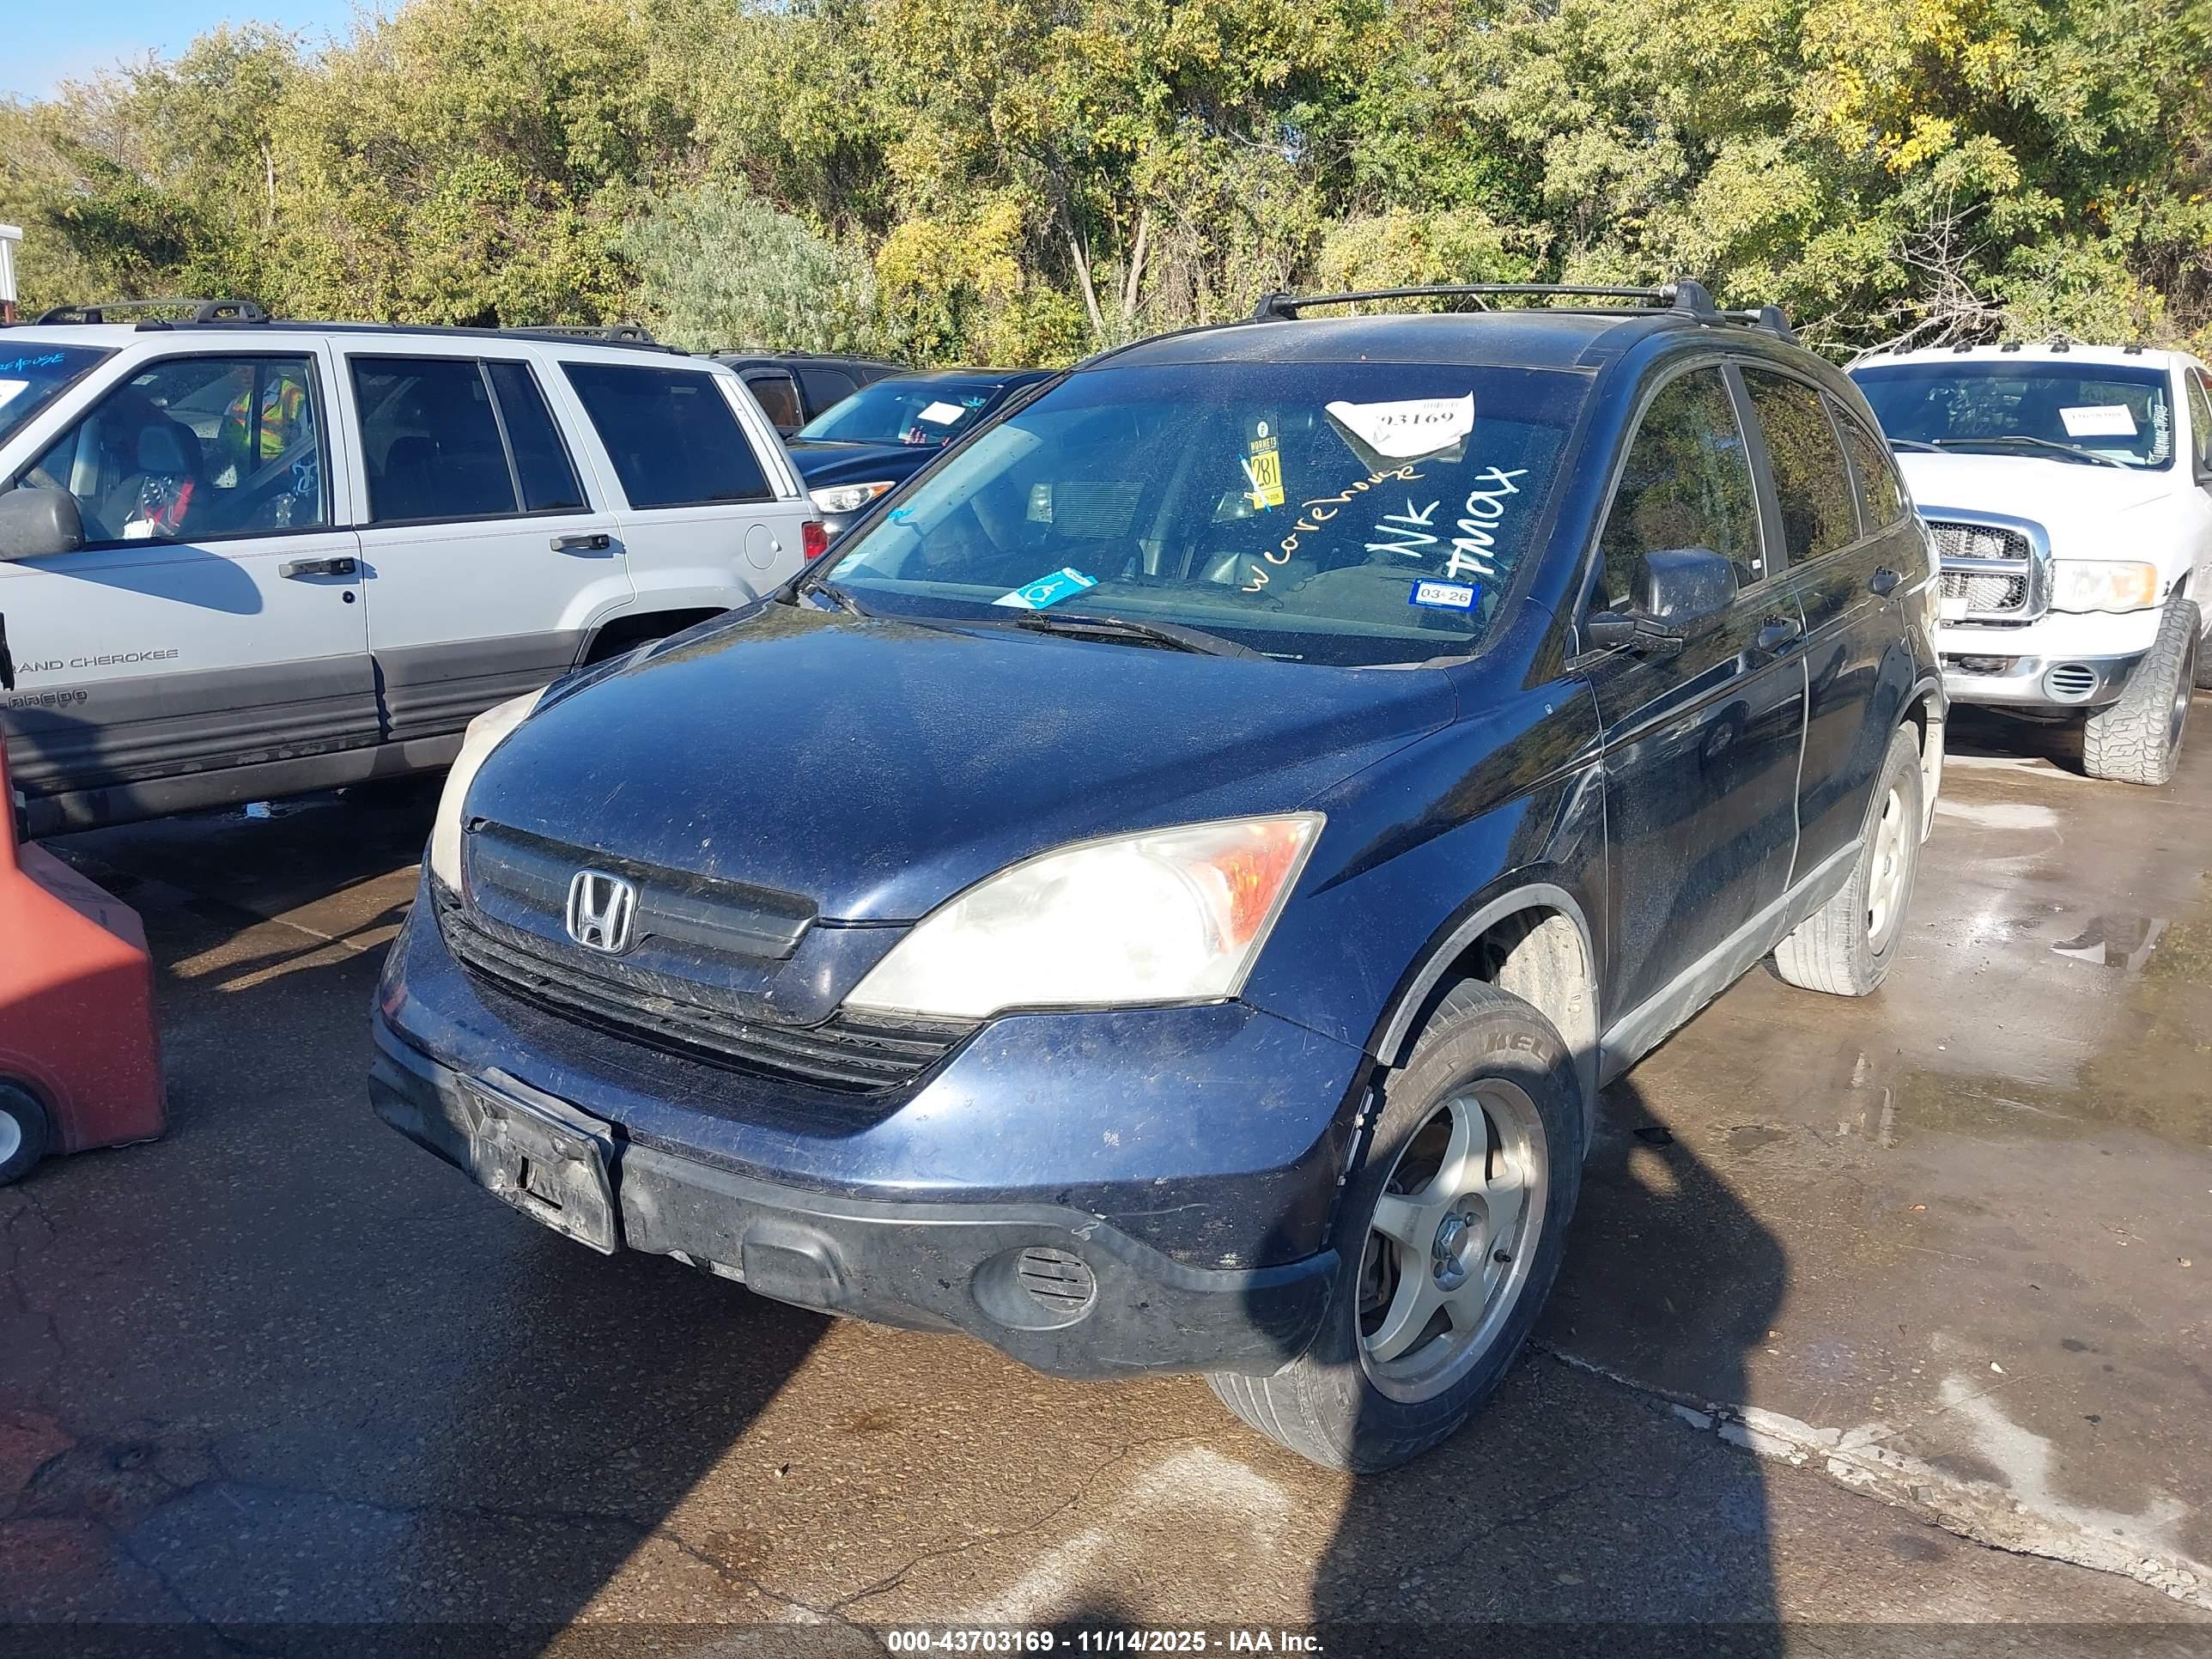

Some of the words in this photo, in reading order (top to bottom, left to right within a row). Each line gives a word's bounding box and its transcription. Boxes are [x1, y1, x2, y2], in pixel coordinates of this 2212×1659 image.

[1253, 456, 1277, 485] 281
[13, 659, 64, 675] AND
[69, 648, 179, 668] CHEROKEE
